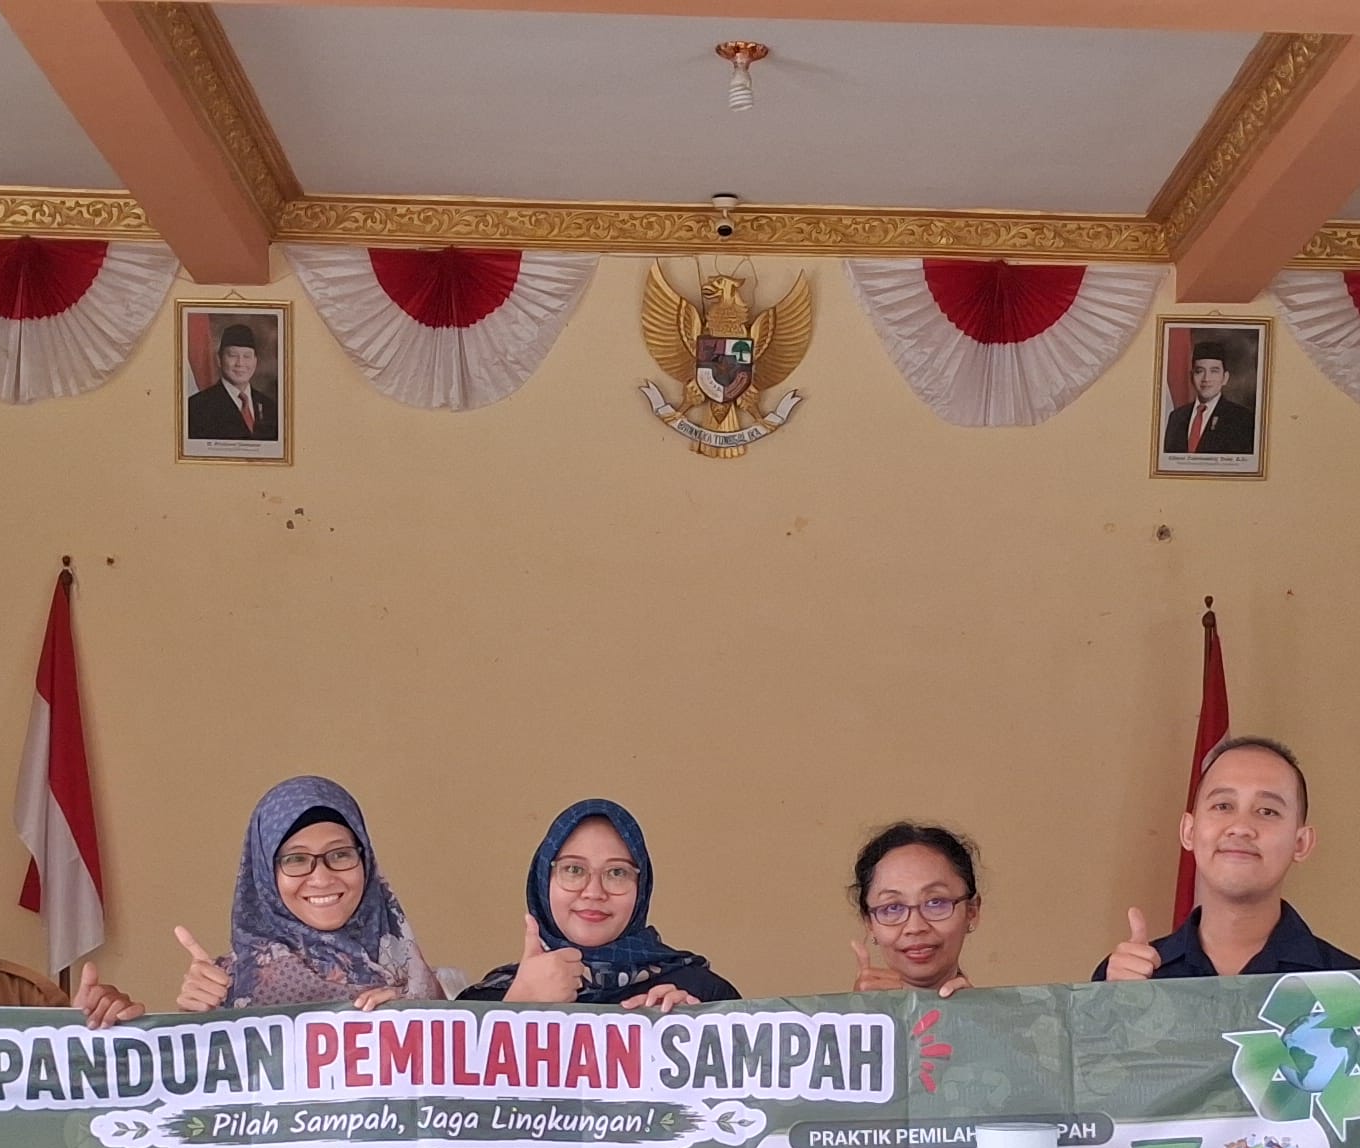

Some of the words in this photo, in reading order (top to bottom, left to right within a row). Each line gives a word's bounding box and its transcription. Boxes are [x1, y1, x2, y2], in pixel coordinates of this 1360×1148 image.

[305, 1019, 642, 1091] PEMILAHAN
[658, 1019, 884, 1094] SAMPAH
[212, 1108, 284, 1139] Pilah
[289, 1107, 408, 1141] Sampah,
[417, 1107, 483, 1141] Jaga
[491, 1103, 656, 1141] Lingkungan!
[809, 1129, 891, 1147] PRAKTIK
